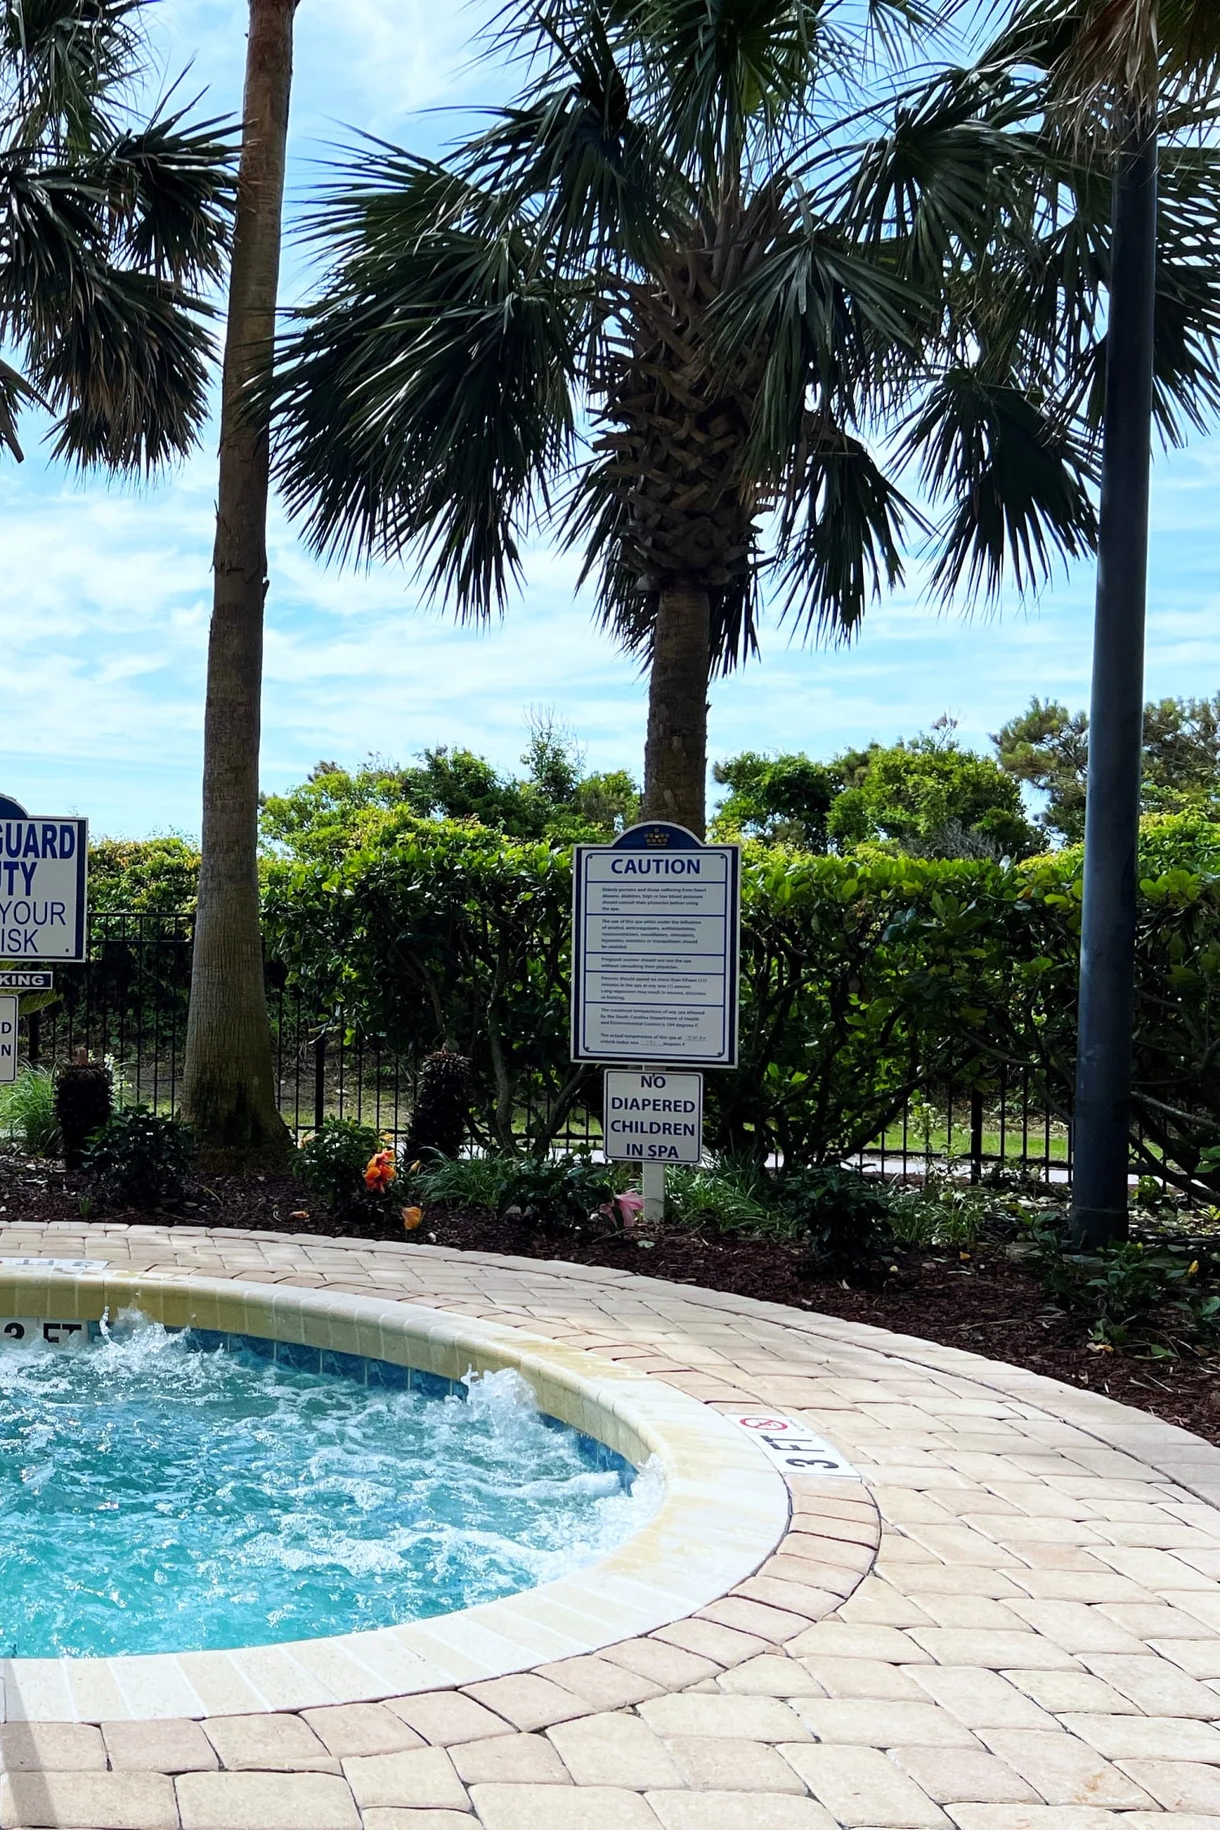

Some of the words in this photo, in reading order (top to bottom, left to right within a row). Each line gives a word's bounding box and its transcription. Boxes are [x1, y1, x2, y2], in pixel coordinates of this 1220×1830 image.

[611, 859, 700, 874] CAUTION
[641, 1076, 666, 1088] NO
[611, 1097, 695, 1113] DIAPERED
[611, 1120, 695, 1136] CHILDREN
[626, 1143, 643, 1156] IN
[648, 1145, 679, 1158] SPA
[760, 1435, 825, 1452] FT
[785, 1458, 839, 1469] 3
